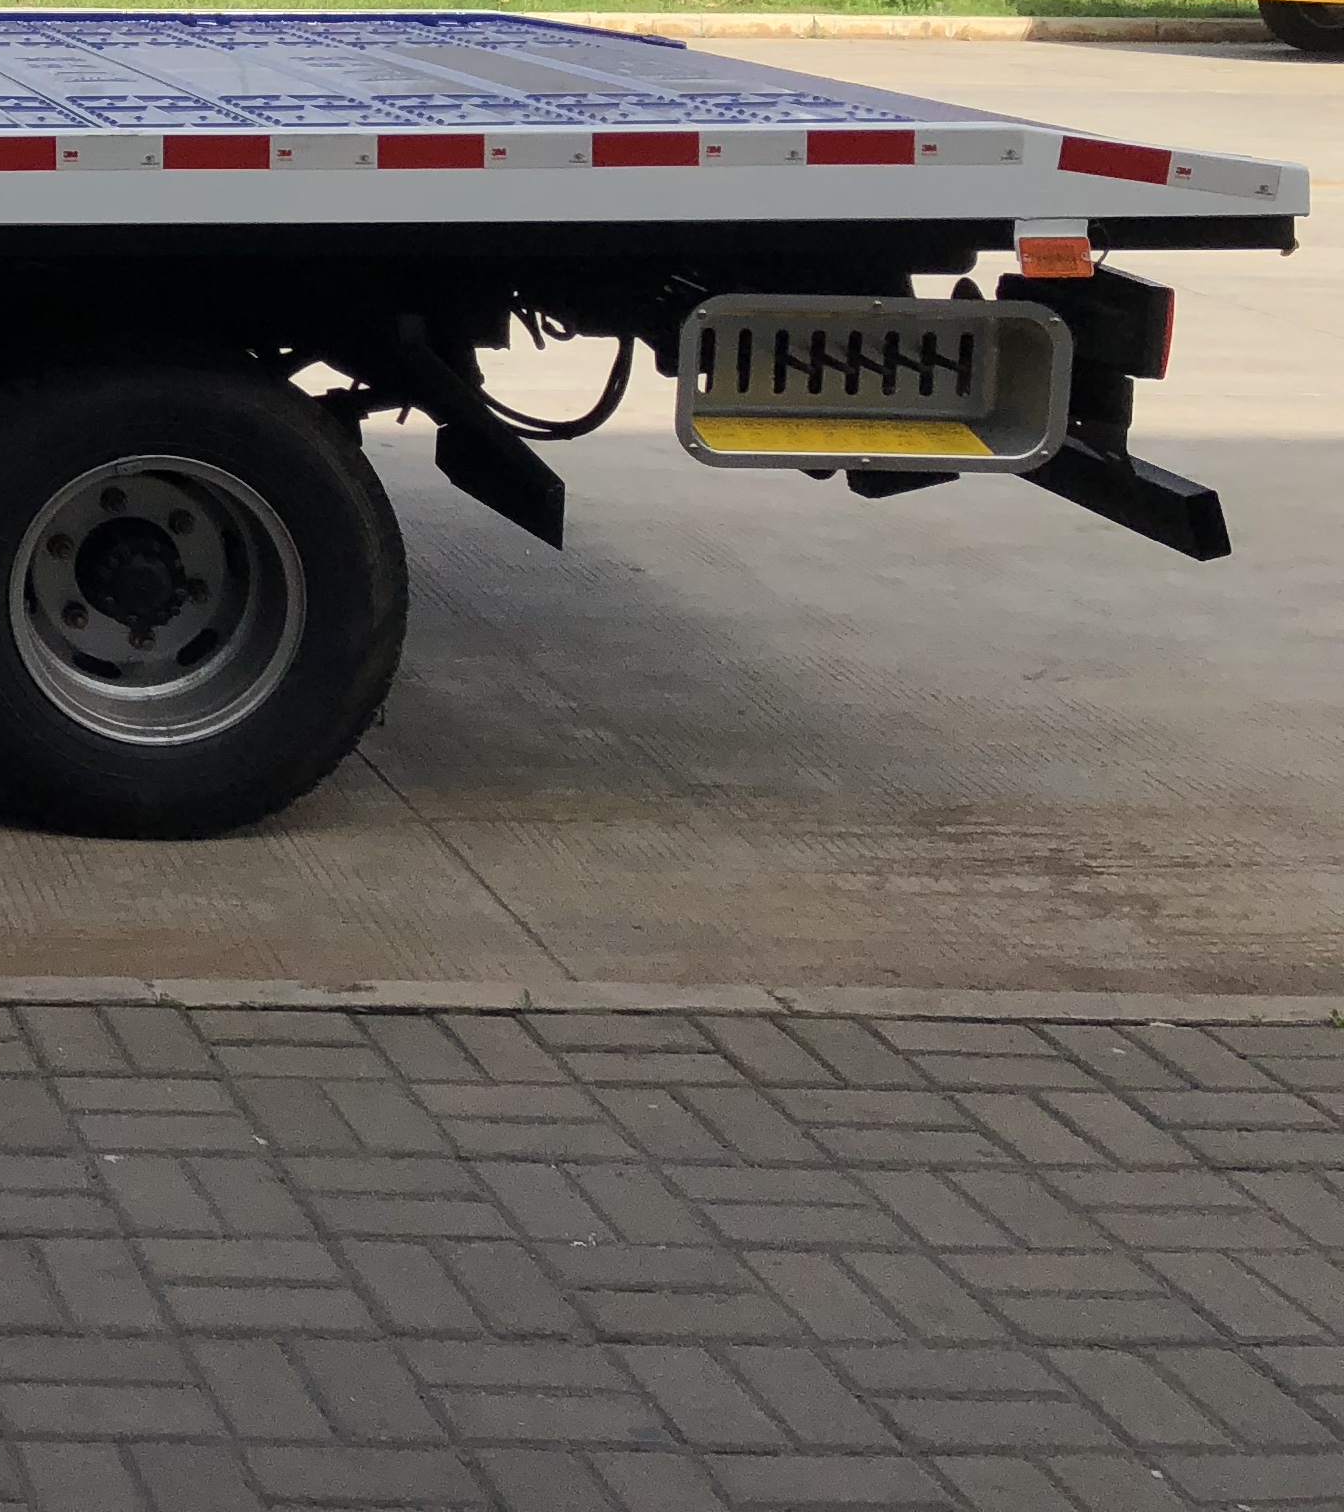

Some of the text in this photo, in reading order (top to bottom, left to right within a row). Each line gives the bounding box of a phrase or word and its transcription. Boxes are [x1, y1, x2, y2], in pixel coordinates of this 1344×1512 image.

[277, 149, 292, 158] 3M
[492, 148, 506, 157] 3M
[706, 146, 721, 155] 3M
[922, 145, 937, 154] 3M
[64, 150, 79, 159] 3M
[1176, 167, 1192, 176] 3M
